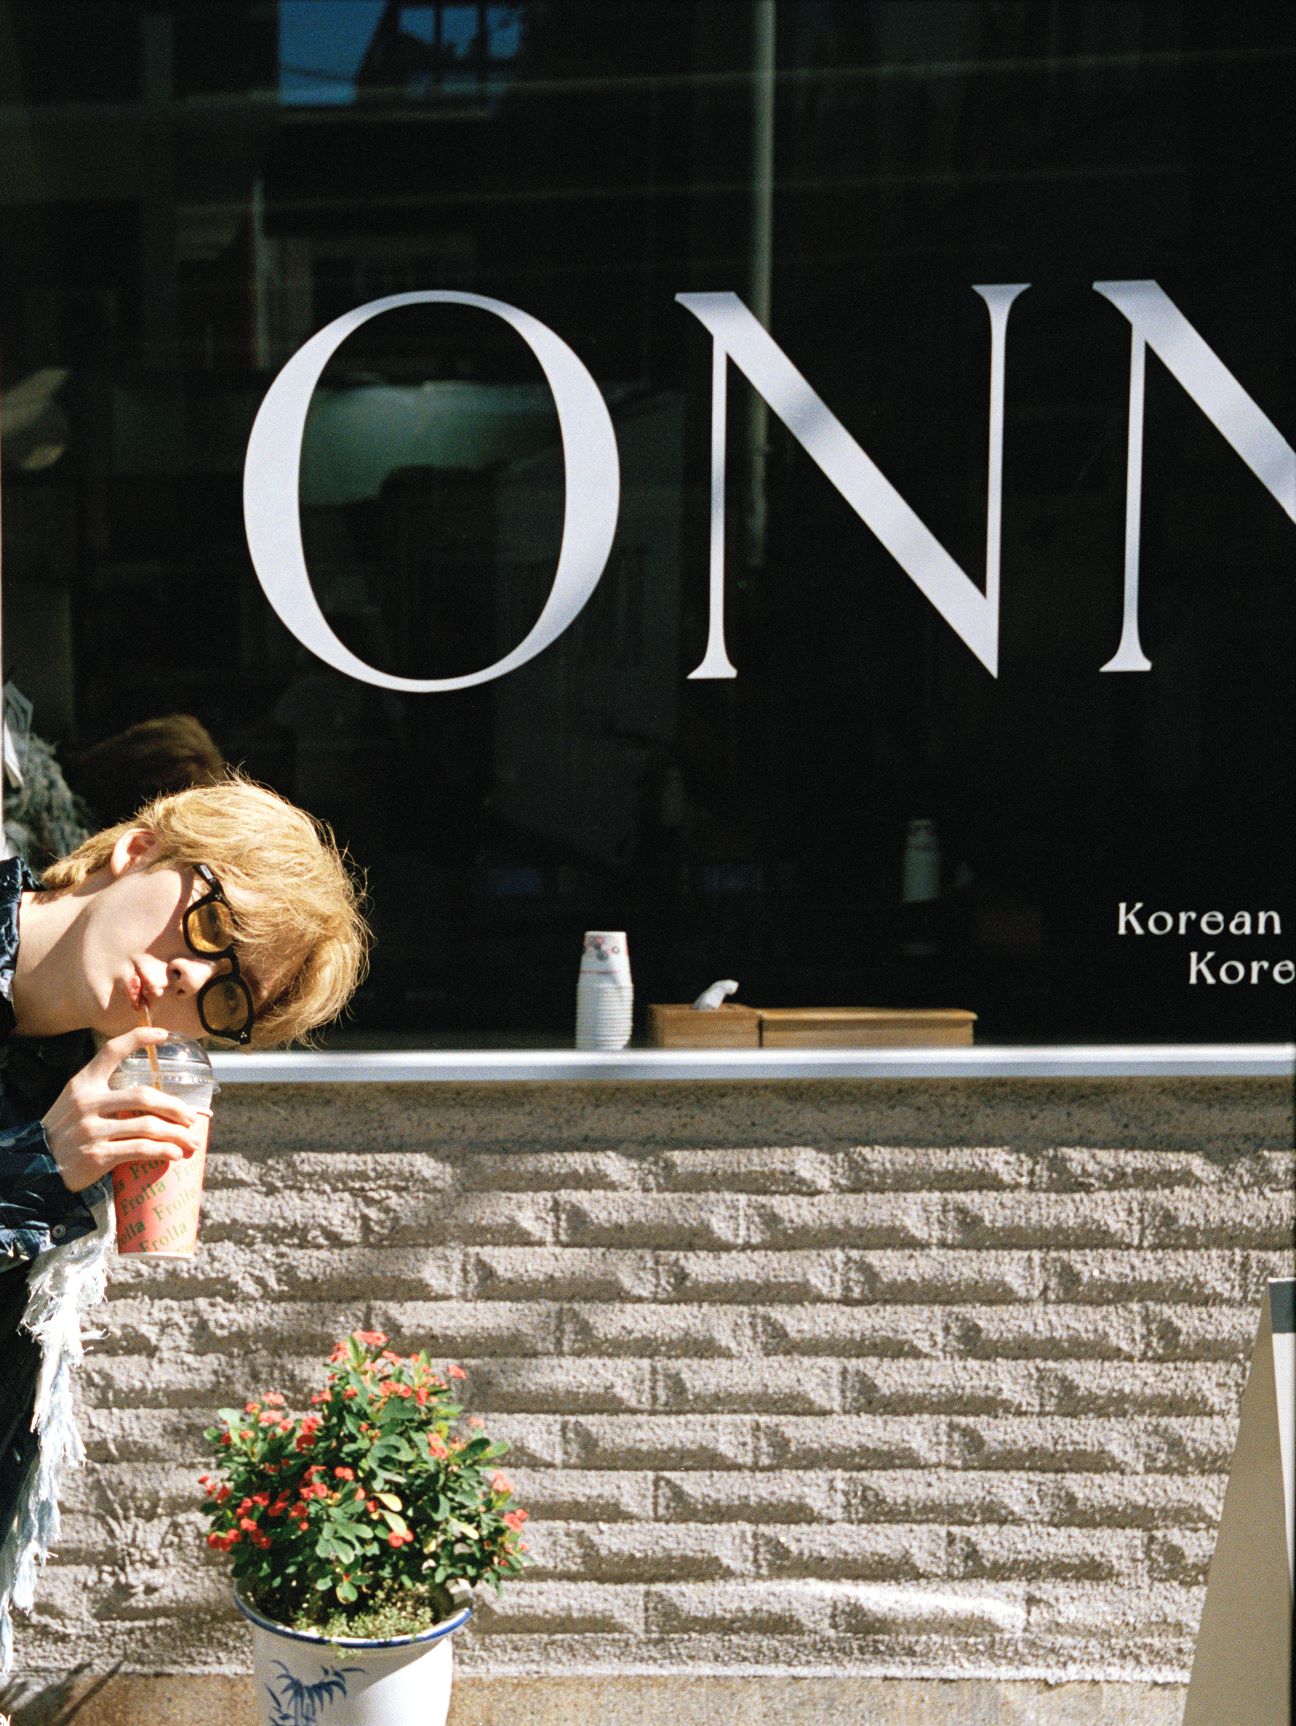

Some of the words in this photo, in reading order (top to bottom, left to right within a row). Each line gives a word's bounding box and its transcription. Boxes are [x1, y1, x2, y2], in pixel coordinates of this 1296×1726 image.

[243, 280, 1296, 693] ONN
[1117, 901, 1282, 936] Korean
[1188, 951, 1296, 985] Kore
[120, 1180, 166, 1216] Frolla
[151, 1186, 198, 1222] Frolla
[138, 1221, 188, 1253] Frolla
